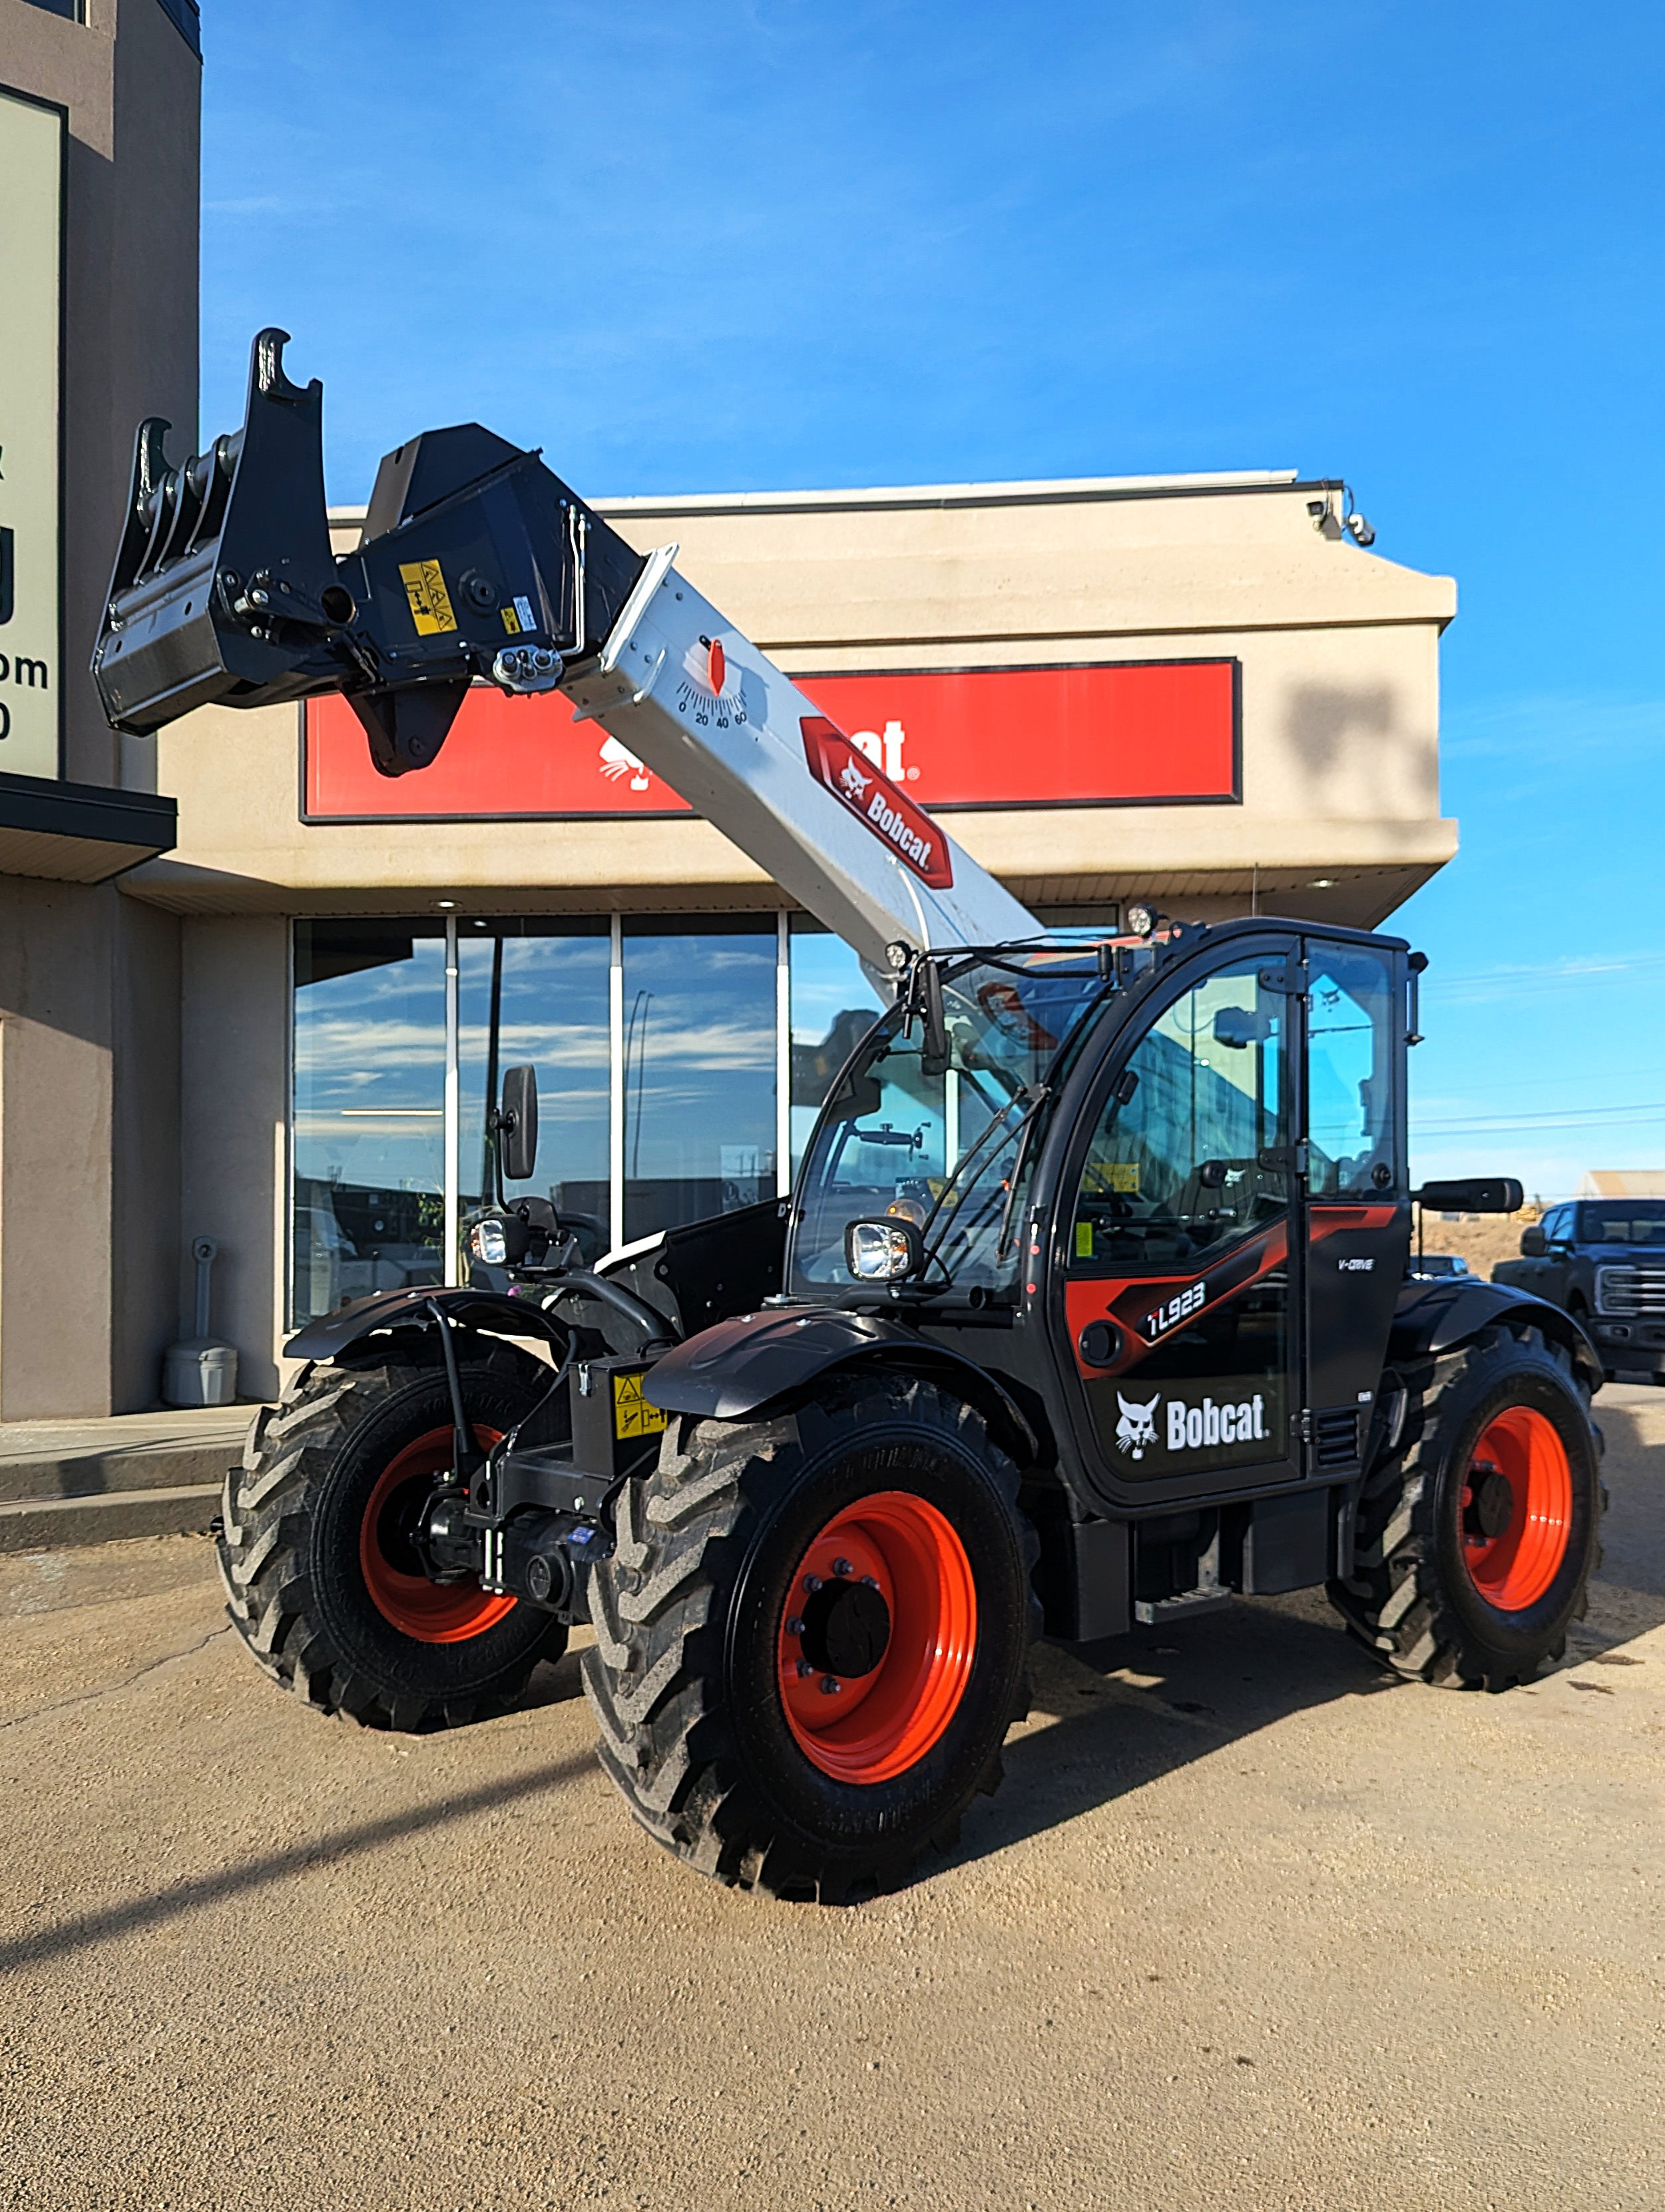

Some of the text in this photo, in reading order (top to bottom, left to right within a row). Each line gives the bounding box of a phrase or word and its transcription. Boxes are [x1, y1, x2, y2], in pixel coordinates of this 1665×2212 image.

[679, 701, 747, 728] 0 20 40 60
[867, 792, 933, 867] Bobcat
[1148, 1282, 1206, 1336] TL923
[1167, 1394, 1264, 1450] Bobcat
